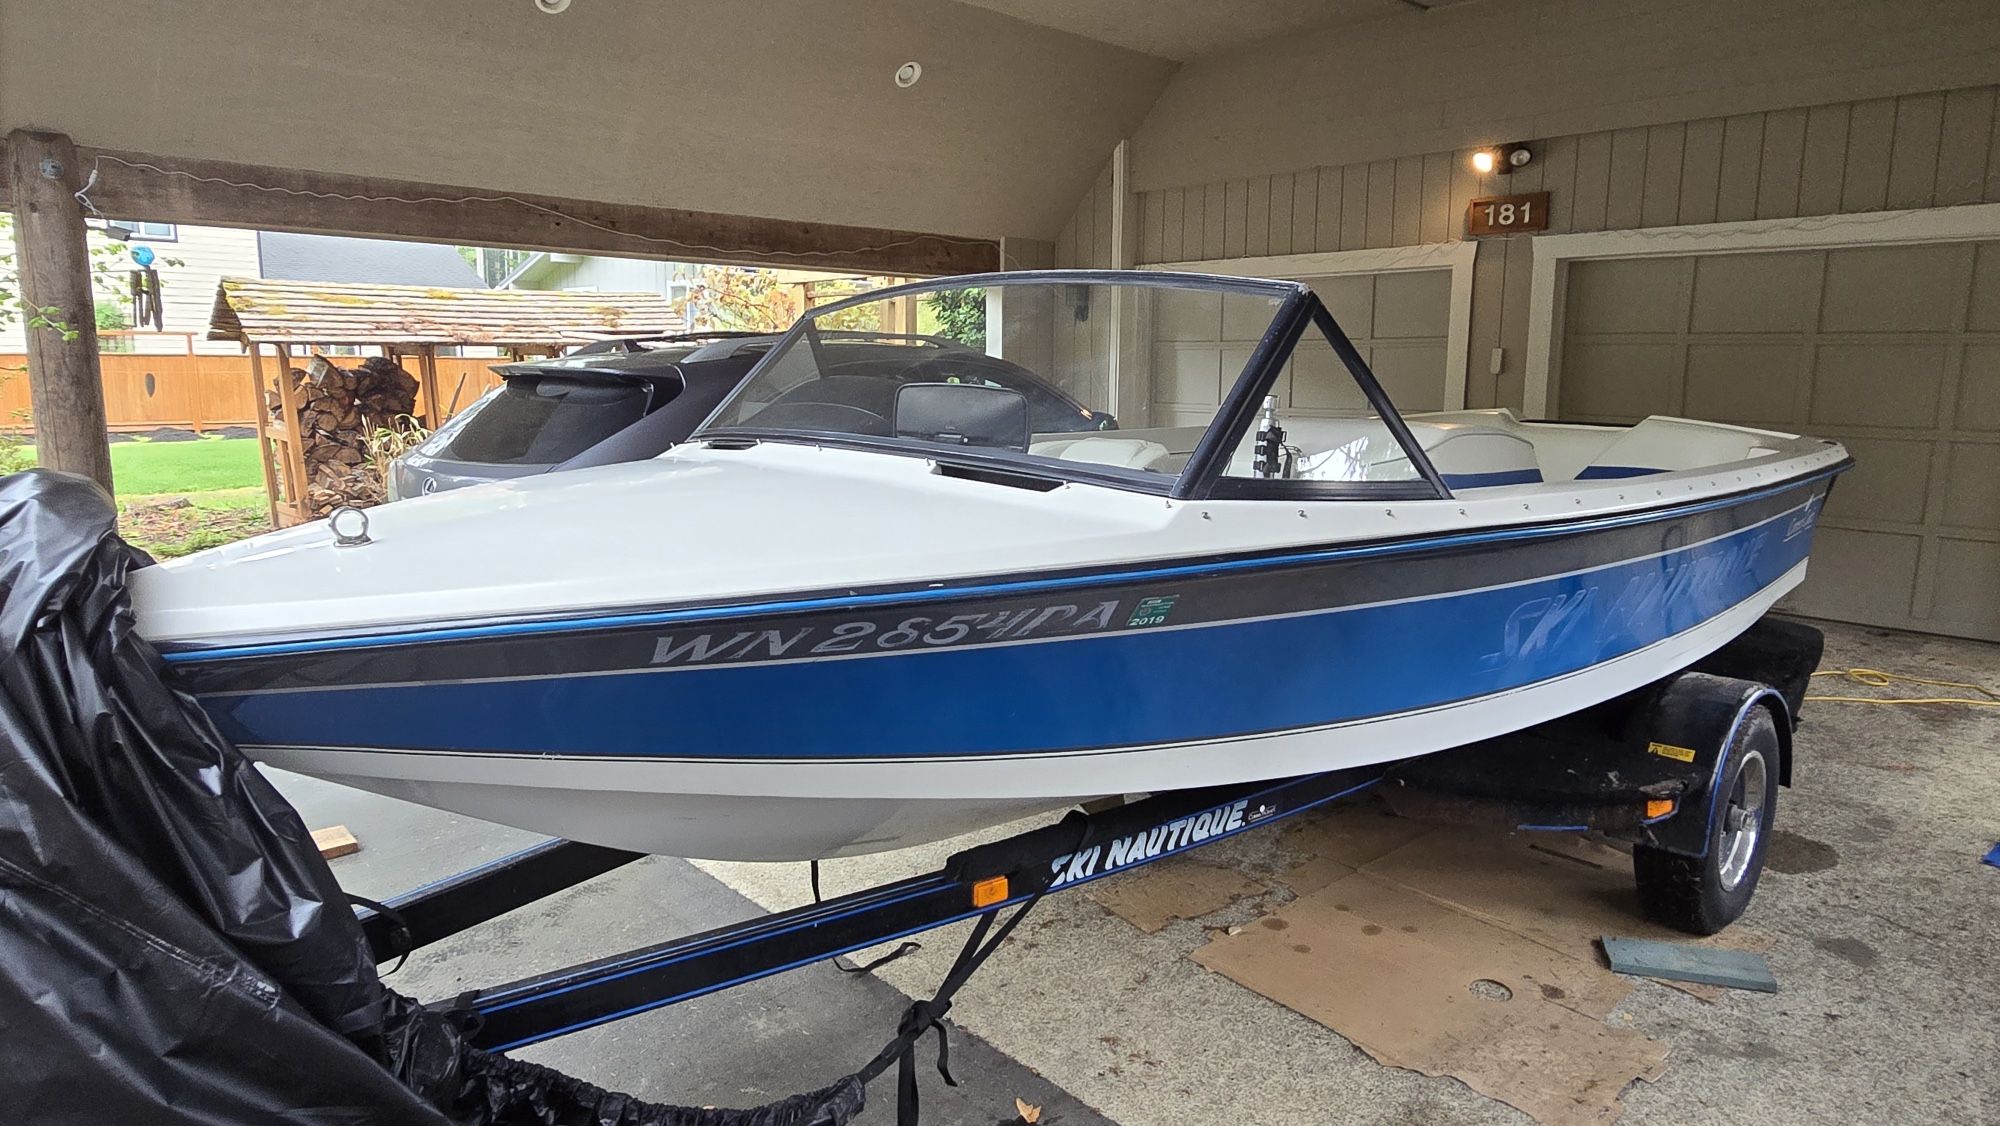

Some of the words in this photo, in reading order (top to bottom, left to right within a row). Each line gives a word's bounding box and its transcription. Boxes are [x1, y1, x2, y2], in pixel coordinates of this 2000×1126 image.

[1484, 201, 1531, 226] 181
[1129, 615, 1165, 626] 2019
[650, 627, 815, 664] WN
[1049, 845, 1101, 888] SKI
